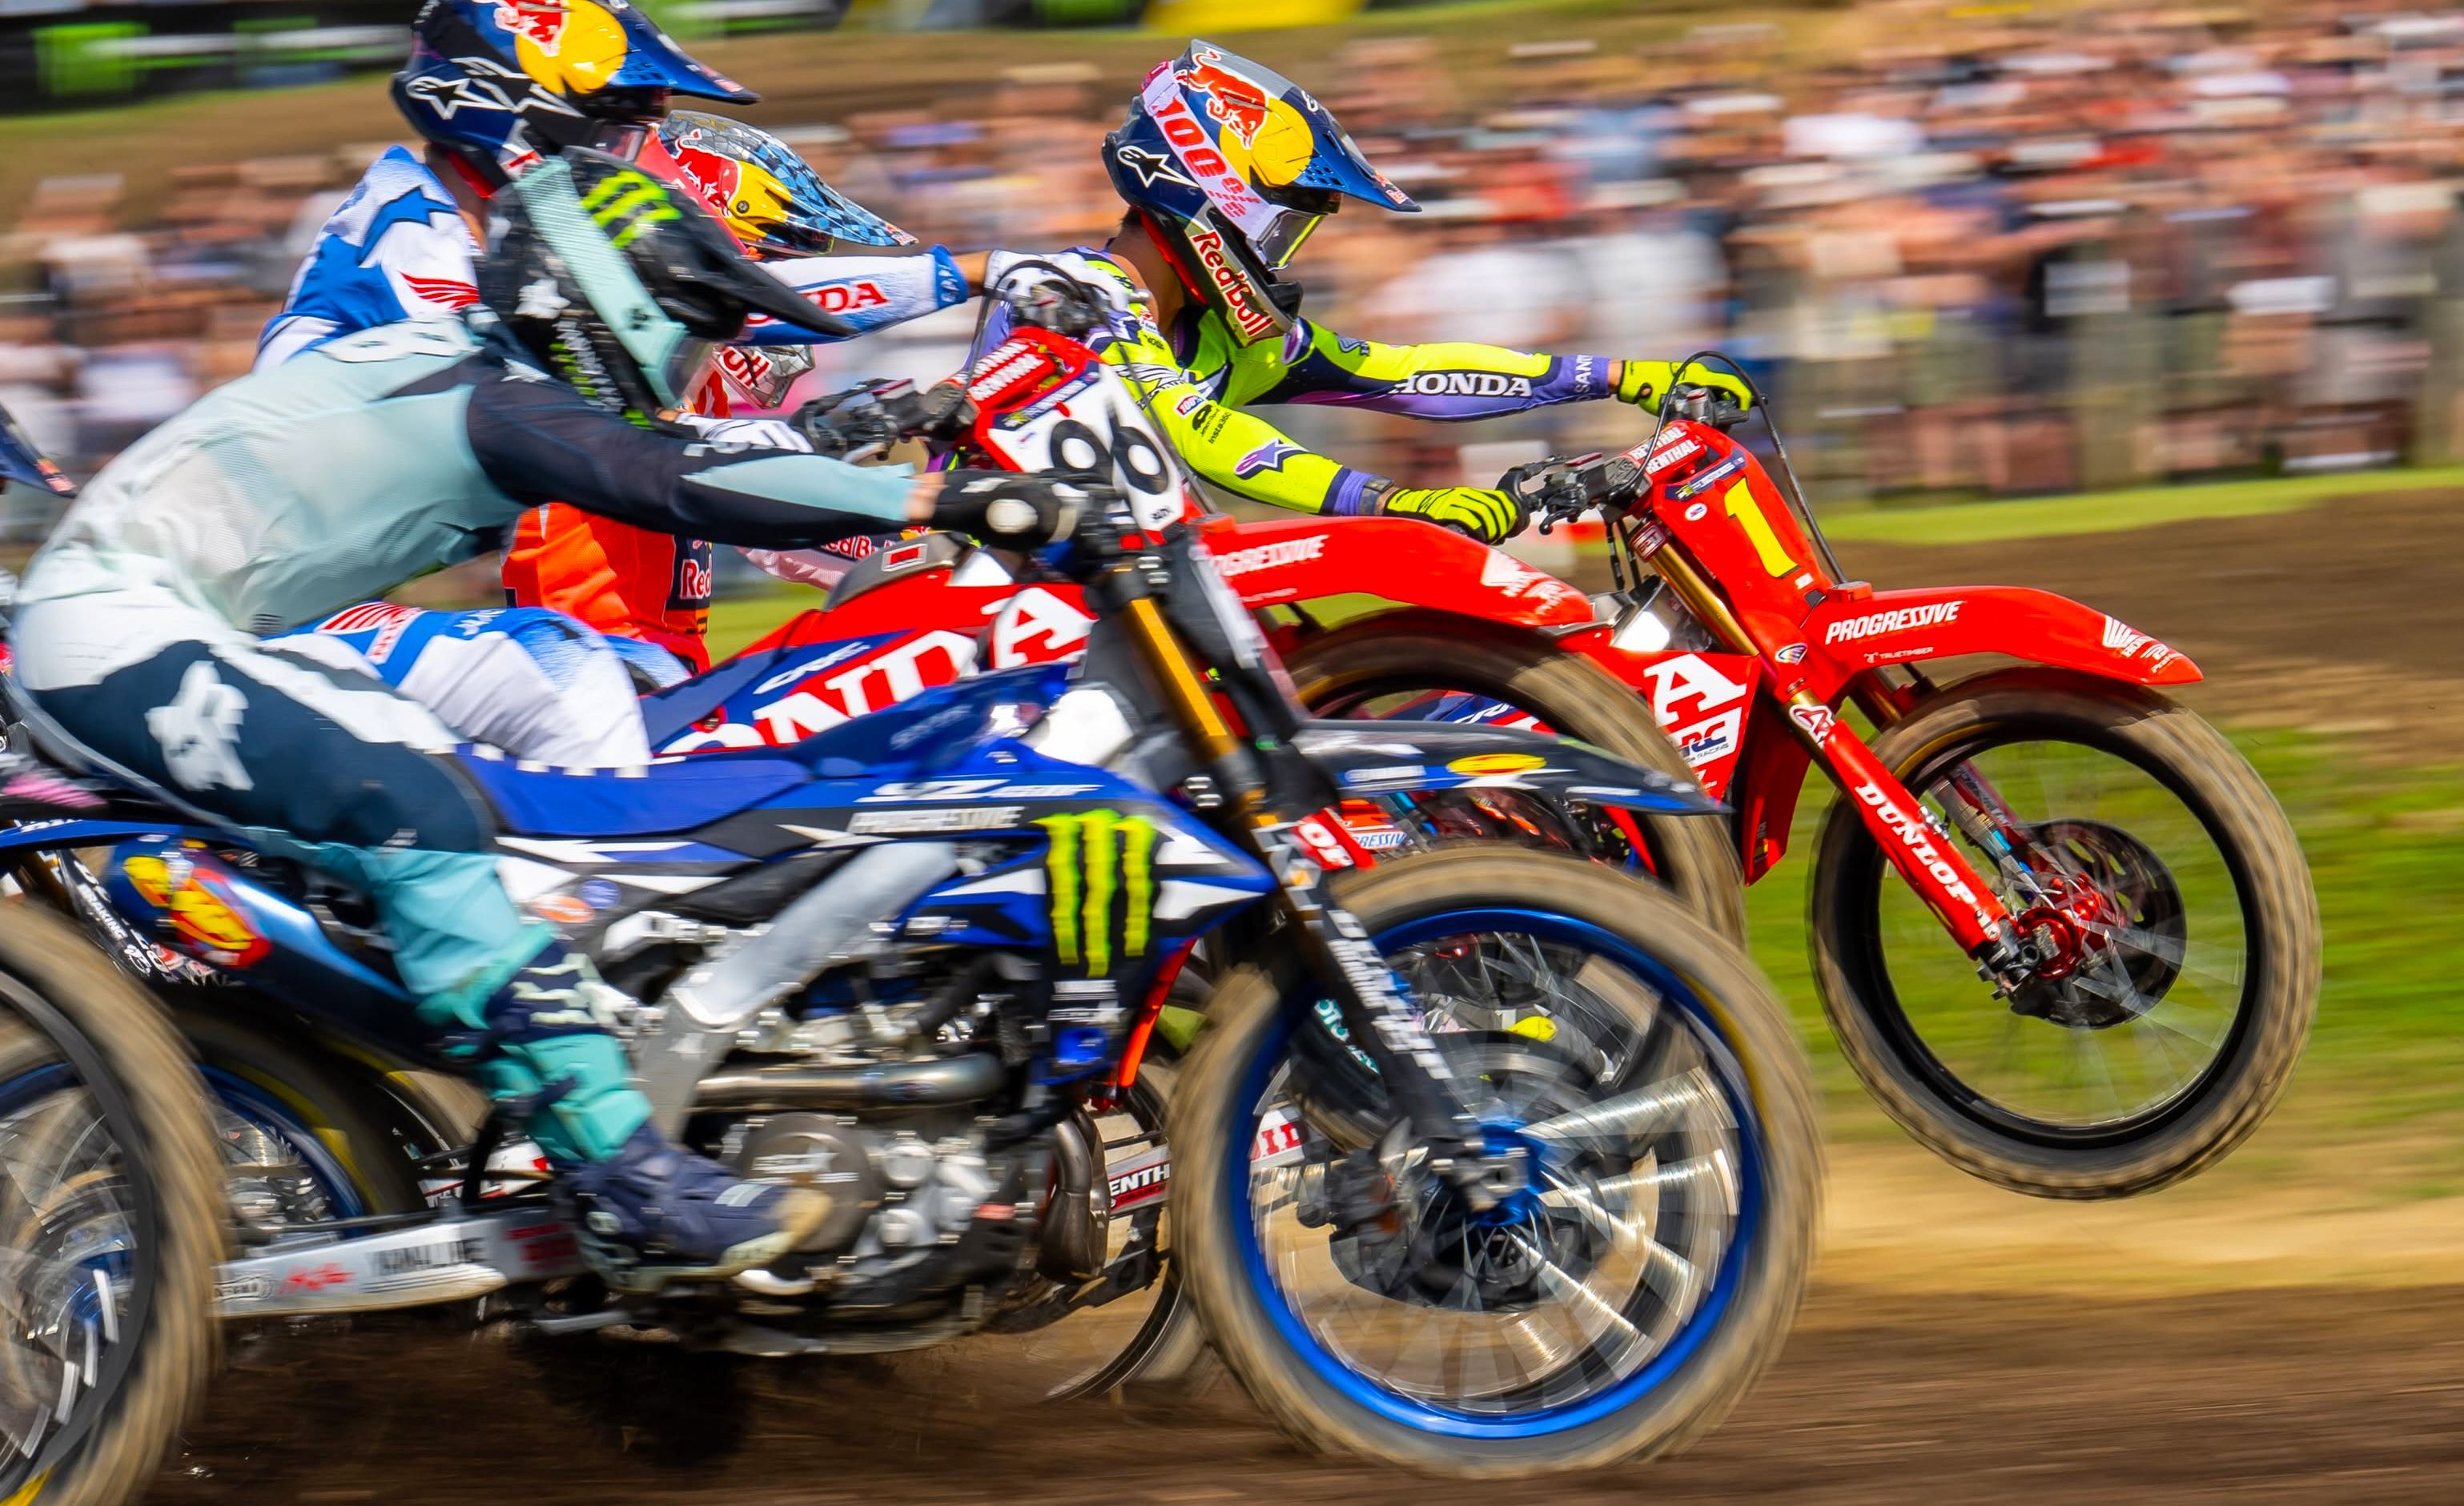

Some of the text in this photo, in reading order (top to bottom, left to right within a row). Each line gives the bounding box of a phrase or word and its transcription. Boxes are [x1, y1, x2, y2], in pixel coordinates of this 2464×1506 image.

[1389, 371, 1533, 397] HONDA
[1724, 476, 1800, 578] 1
[1824, 600, 1967, 645] PROGRESSIVE
[1855, 781, 1977, 905] DUNLOP
[1109, 1163, 1170, 1195] ENTH
